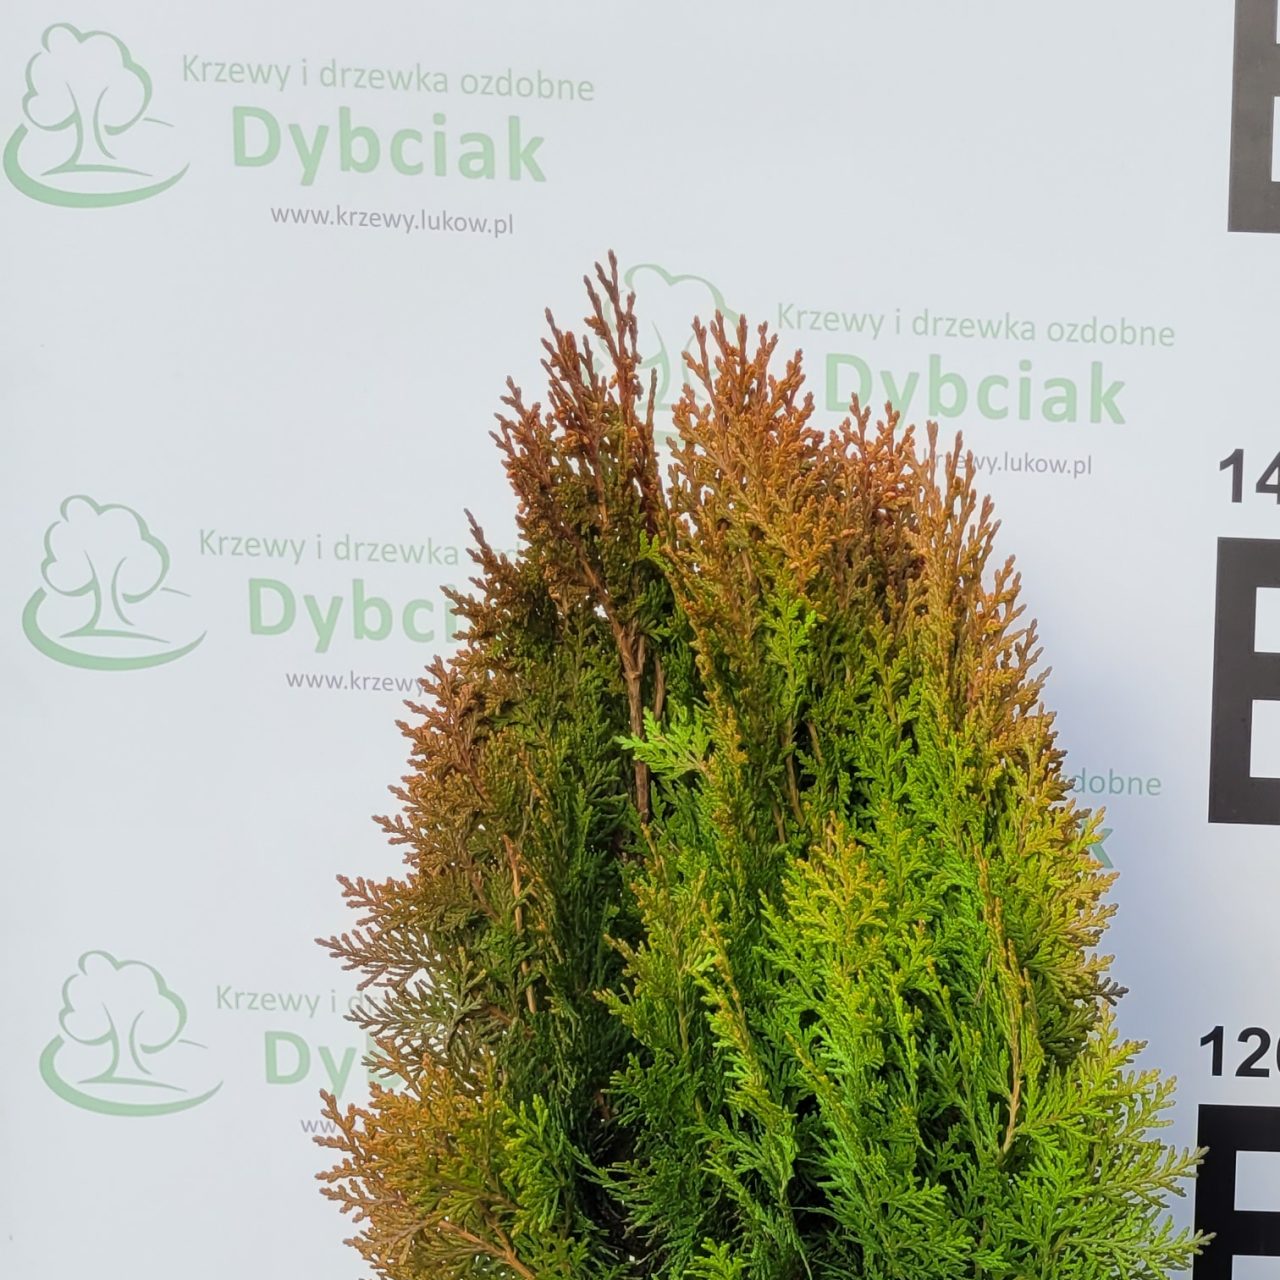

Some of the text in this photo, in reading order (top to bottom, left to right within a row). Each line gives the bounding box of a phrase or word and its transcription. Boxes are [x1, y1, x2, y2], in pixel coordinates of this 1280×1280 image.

[181, 54, 595, 103] Krzewy i drzewka ozdobne
[232, 106, 547, 186] Dybciak
[271, 205, 514, 238] www.krzewy.lukow.pl
[777, 303, 1175, 347] Krzewy i drzewka ozdobne
[825, 353, 1126, 429] Dybciak
[200, 529, 306, 564] Krzewy
[316, 533, 323, 559] i
[334, 534, 459, 565] drzewka
[216, 985, 320, 1018] Krzewy
[330, 989, 337, 1013] i
